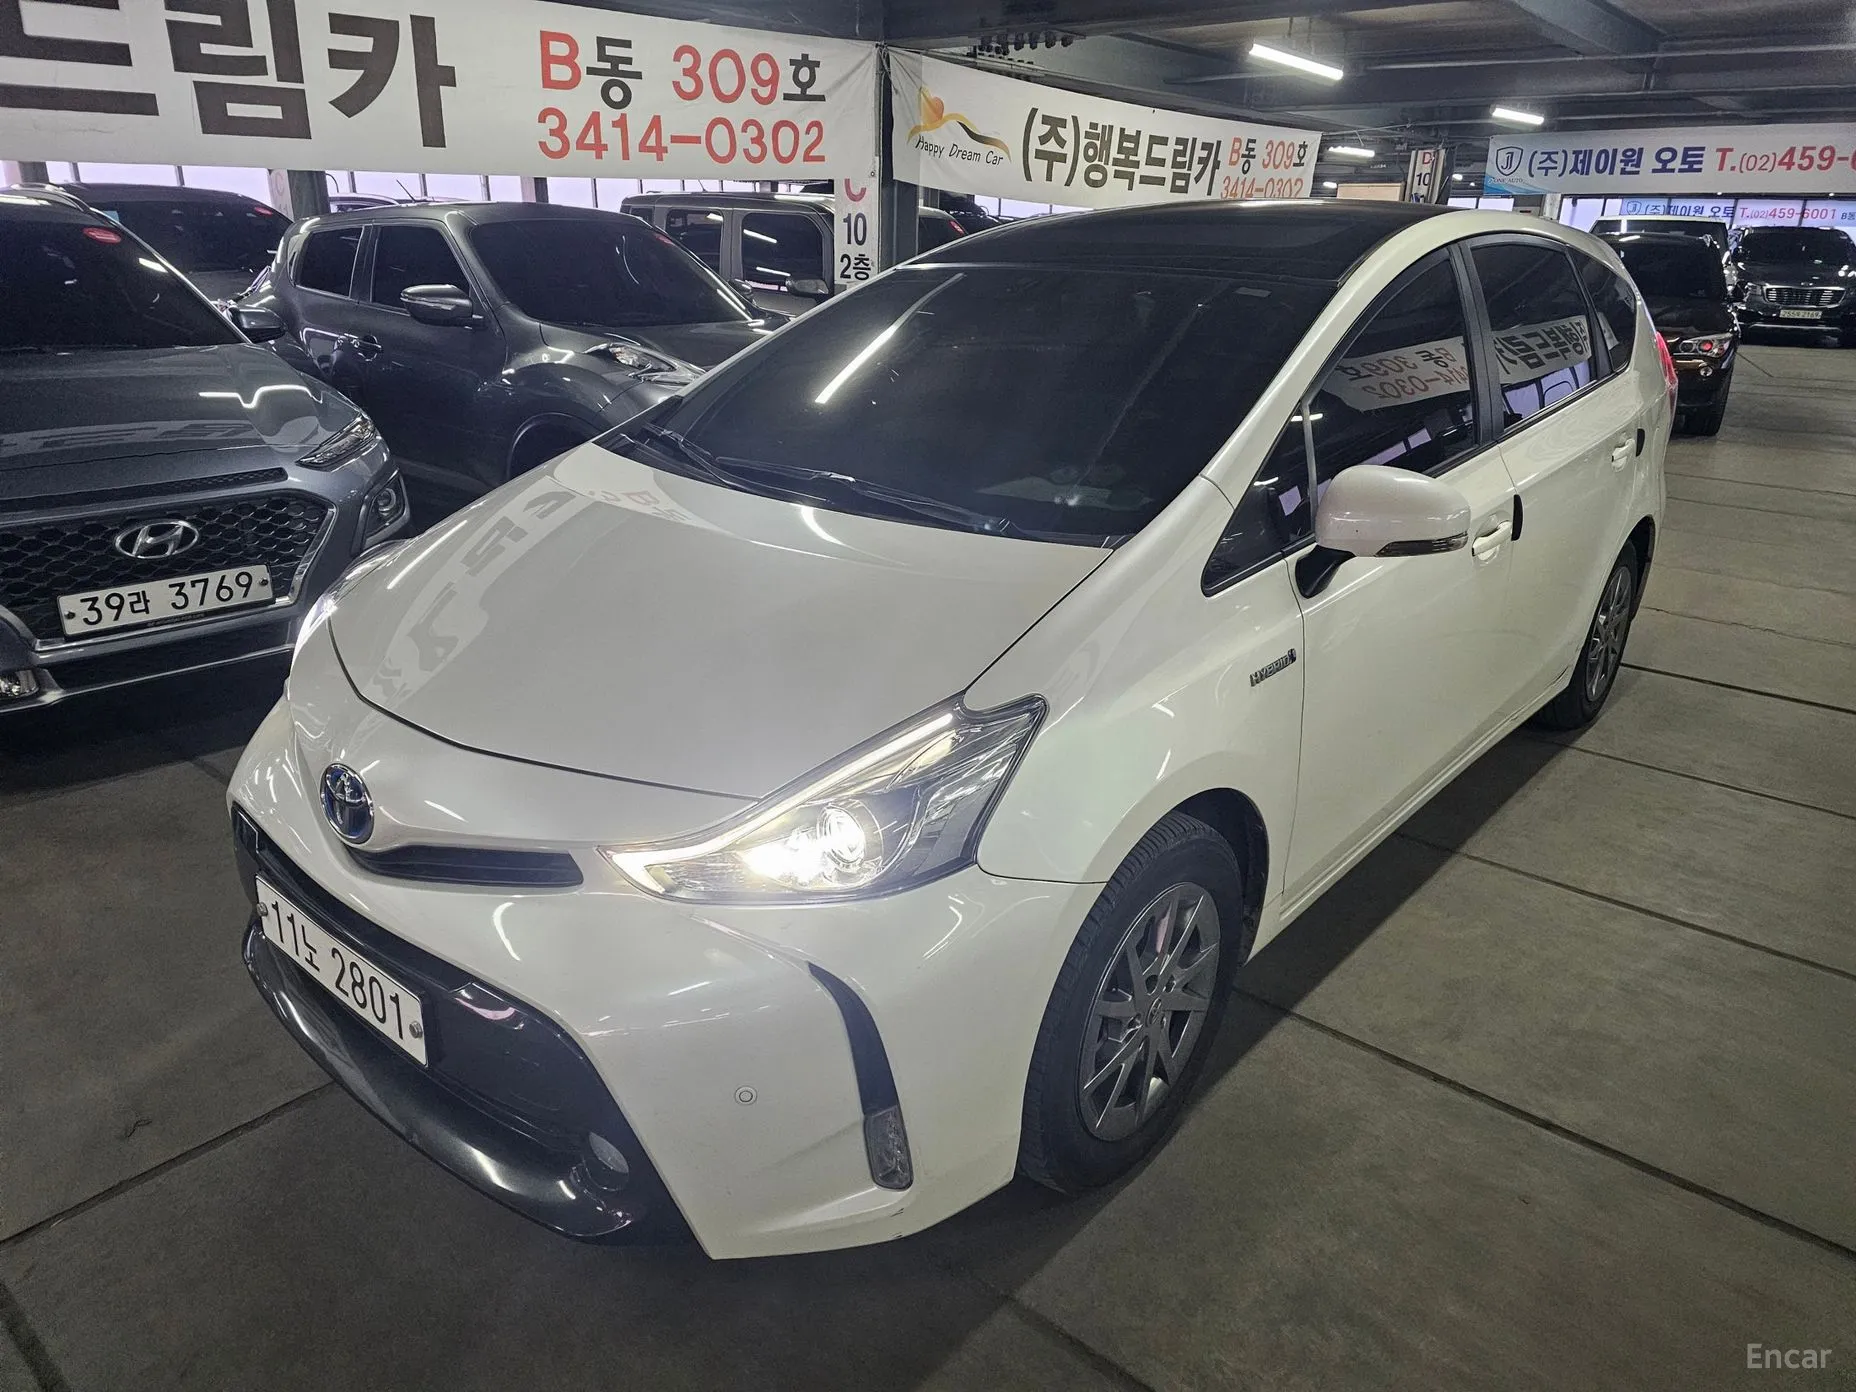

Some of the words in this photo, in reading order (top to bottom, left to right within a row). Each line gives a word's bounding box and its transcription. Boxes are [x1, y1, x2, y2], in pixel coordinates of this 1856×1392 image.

[539, 30, 643, 110] B동
[671, 44, 827, 106] 309호
[537, 106, 827, 164] 3414-0302
[915, 134, 945, 159] Happy
[948, 143, 981, 162] Dream
[985, 150, 1004, 165] Car
[1022, 106, 1222, 196] (주)행복드림카
[1228, 136, 1257, 176] B동
[1262, 139, 1309, 170] 309호
[1527, 147, 1645, 177] (주)제이원
[1651, 146, 1706, 174] 오토
[1715, 145, 1856, 174] T.(02)459-
[843, 212, 867, 246] 10
[840, 253, 871, 281] 2층
[80, 590, 150, 626] 39라
[168, 571, 254, 610] 3769
[272, 901, 320, 972] 11노
[331, 947, 404, 1040] 2801
